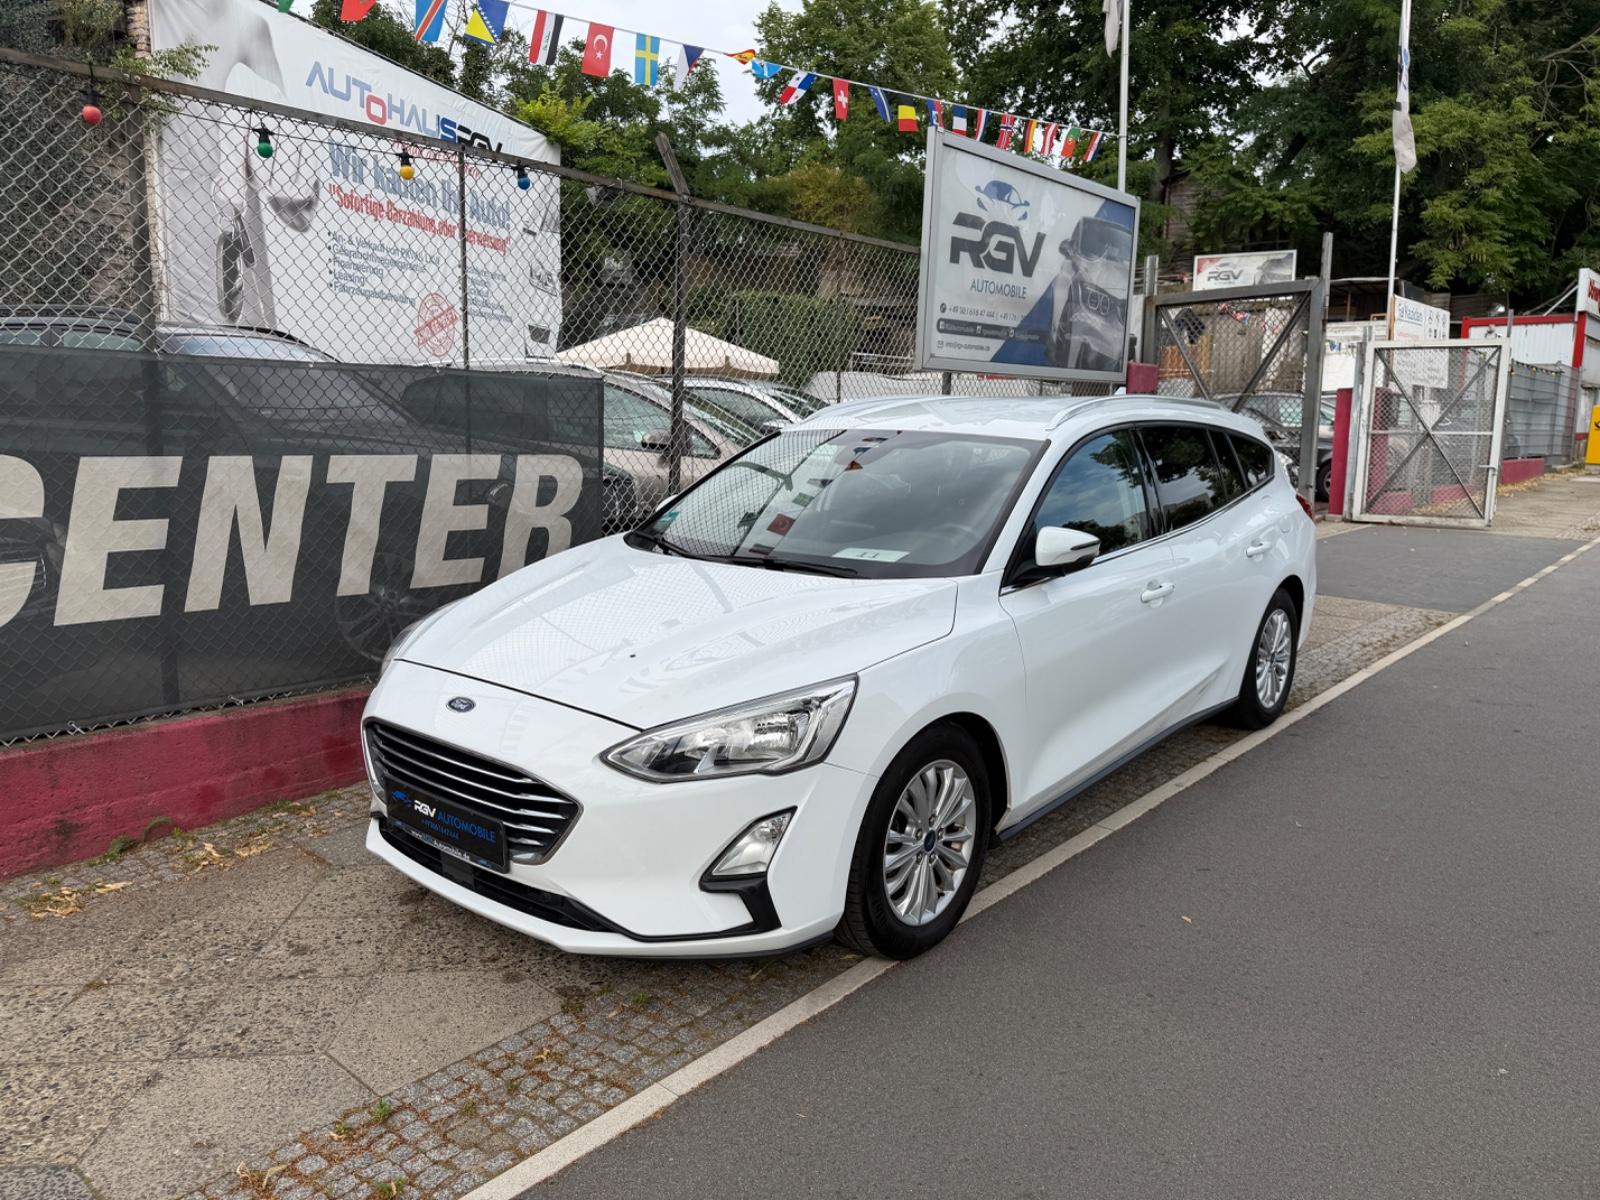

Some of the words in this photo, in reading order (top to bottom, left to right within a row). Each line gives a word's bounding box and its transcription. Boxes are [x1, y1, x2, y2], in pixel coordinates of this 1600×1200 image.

[950, 212, 1046, 278] RGV
[970, 279, 1027, 300] AUTOMOBILE
[1207, 270, 1243, 282] RGV
[414, 800, 436, 818] RGV
[437, 812, 496, 842] AUTOMOBILE
